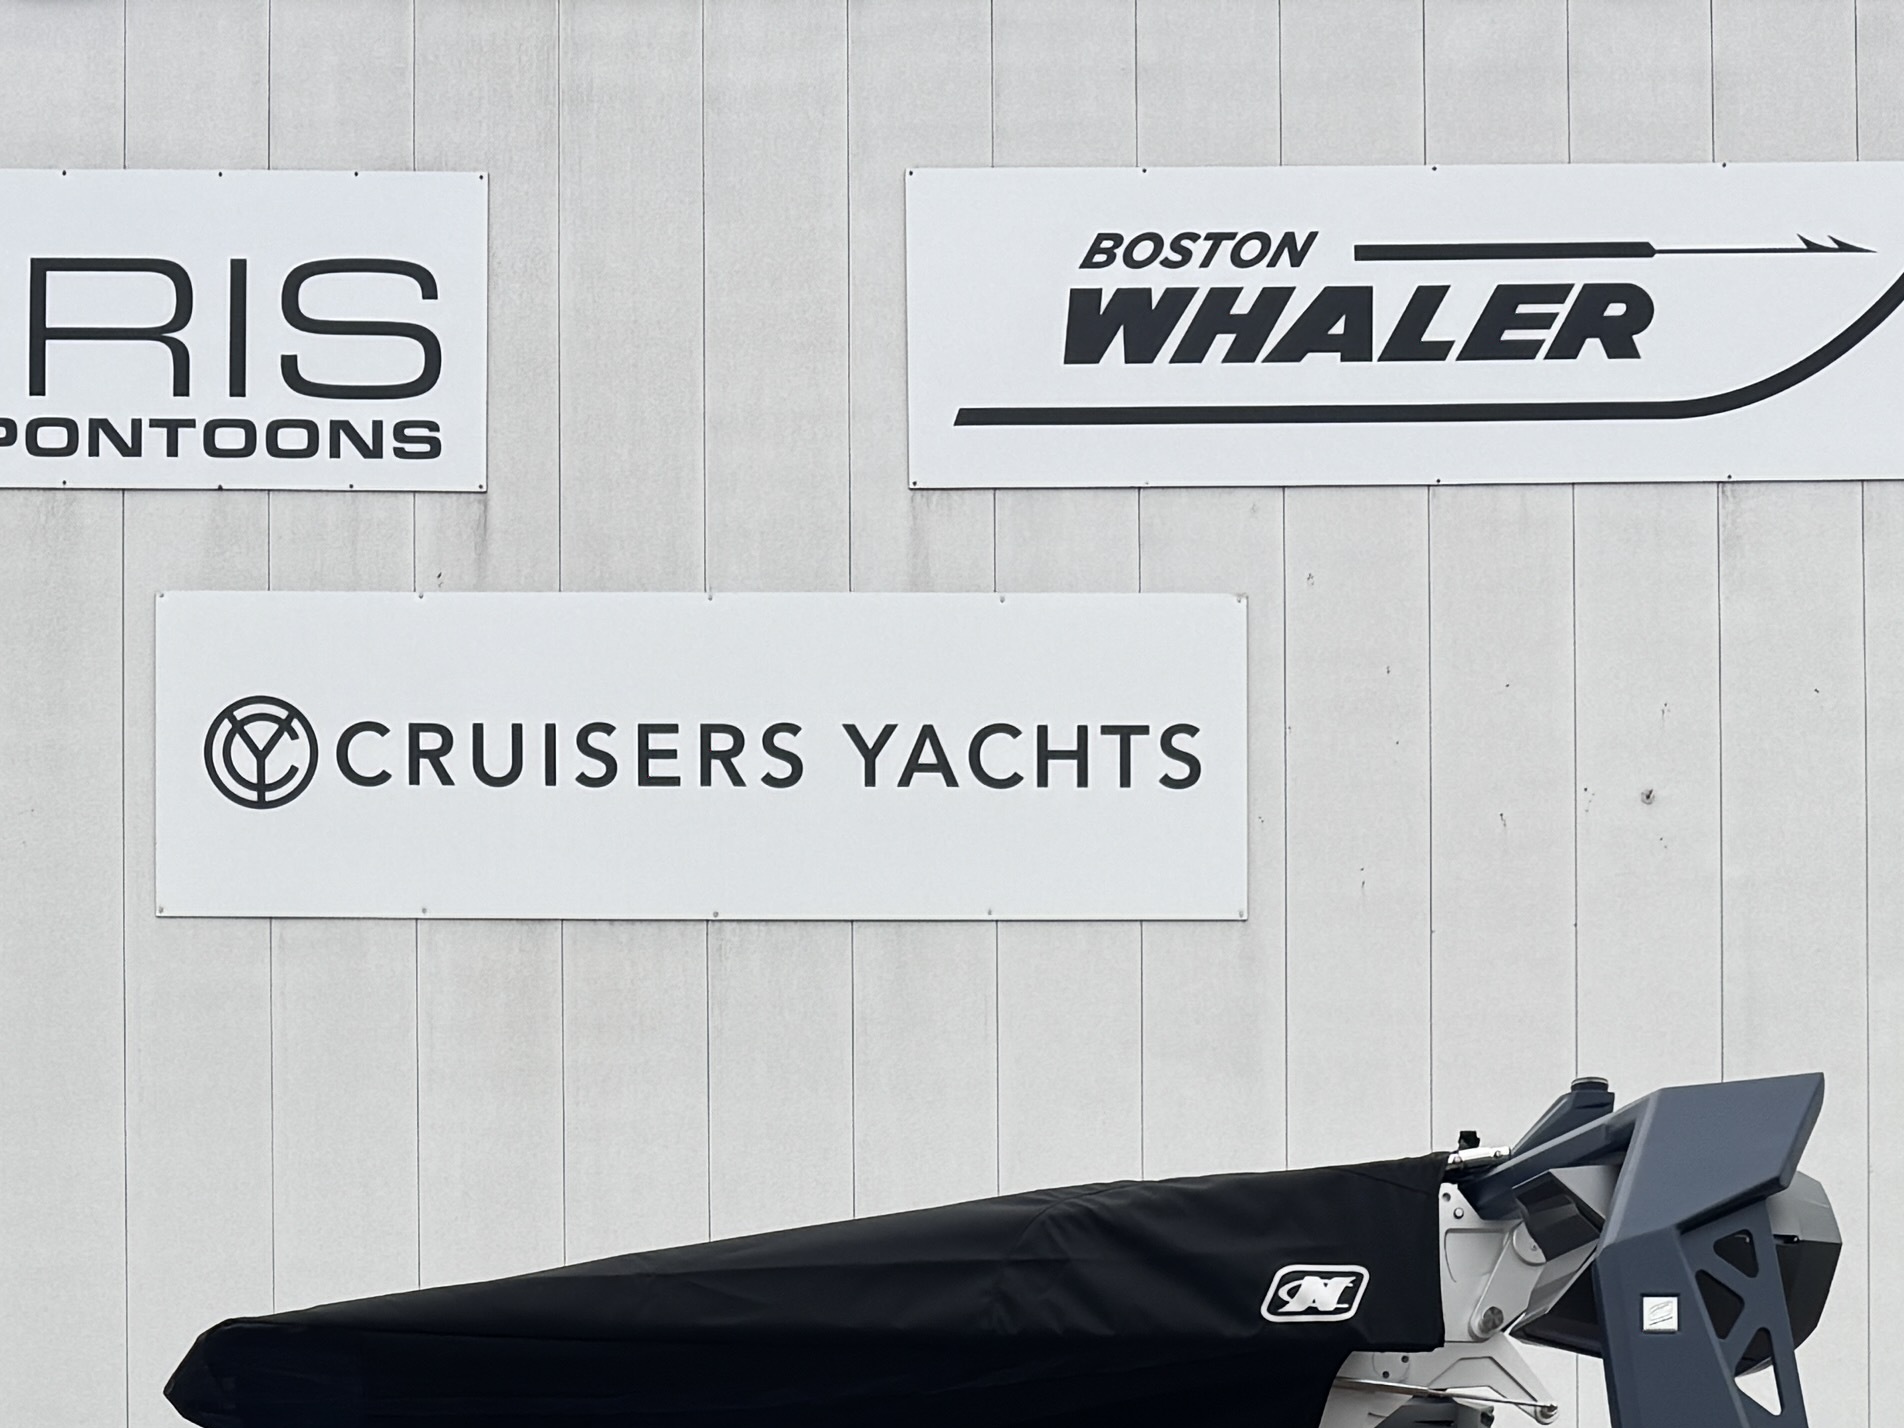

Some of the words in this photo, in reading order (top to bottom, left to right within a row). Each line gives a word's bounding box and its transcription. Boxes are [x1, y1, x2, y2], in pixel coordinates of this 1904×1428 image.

[1078, 230, 1319, 270] BOSTON
[1063, 282, 1655, 365] WHALER
[336, 720, 804, 789] CRUISERS
[842, 722, 1202, 790] YACHTS
